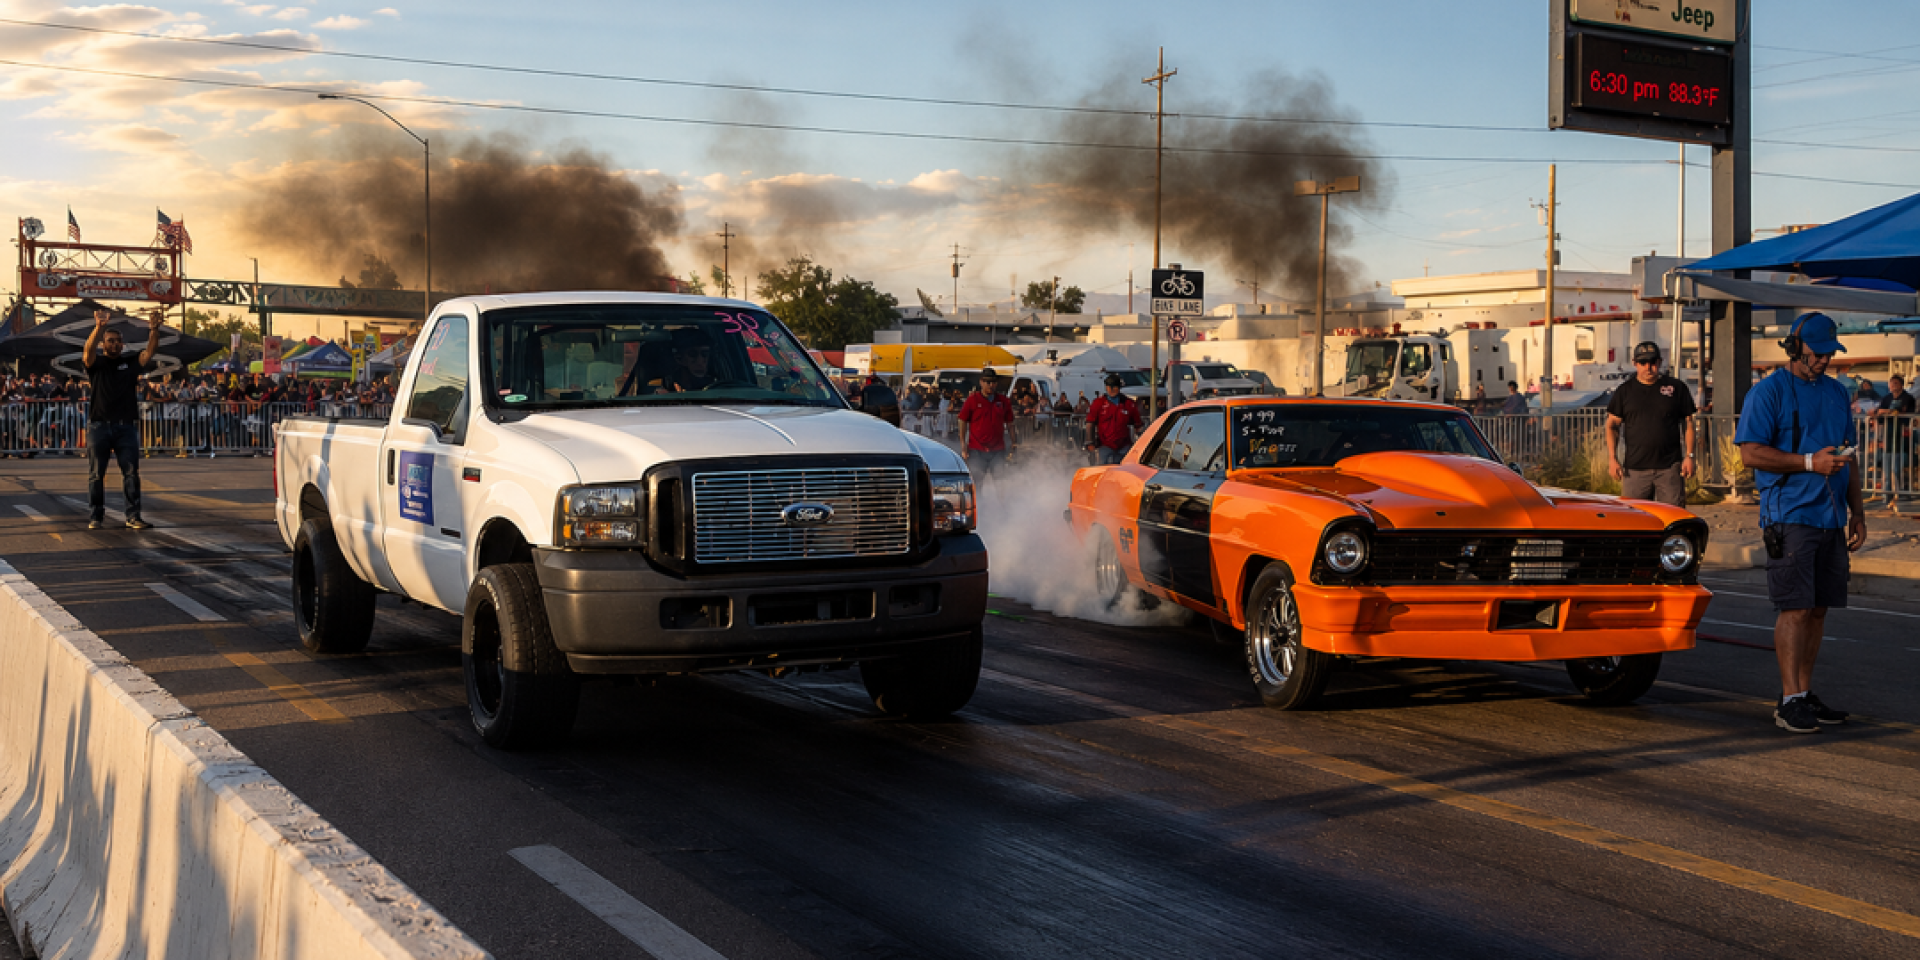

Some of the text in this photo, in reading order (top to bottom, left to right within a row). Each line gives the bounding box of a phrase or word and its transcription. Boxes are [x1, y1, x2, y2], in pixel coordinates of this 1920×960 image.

[1671, 0, 1715, 32] Jeep
[1590, 70, 1720, 107] 6:30 pm 88.3°F
[714, 312, 759, 333] 30
[796, 508, 823, 520] Ford
